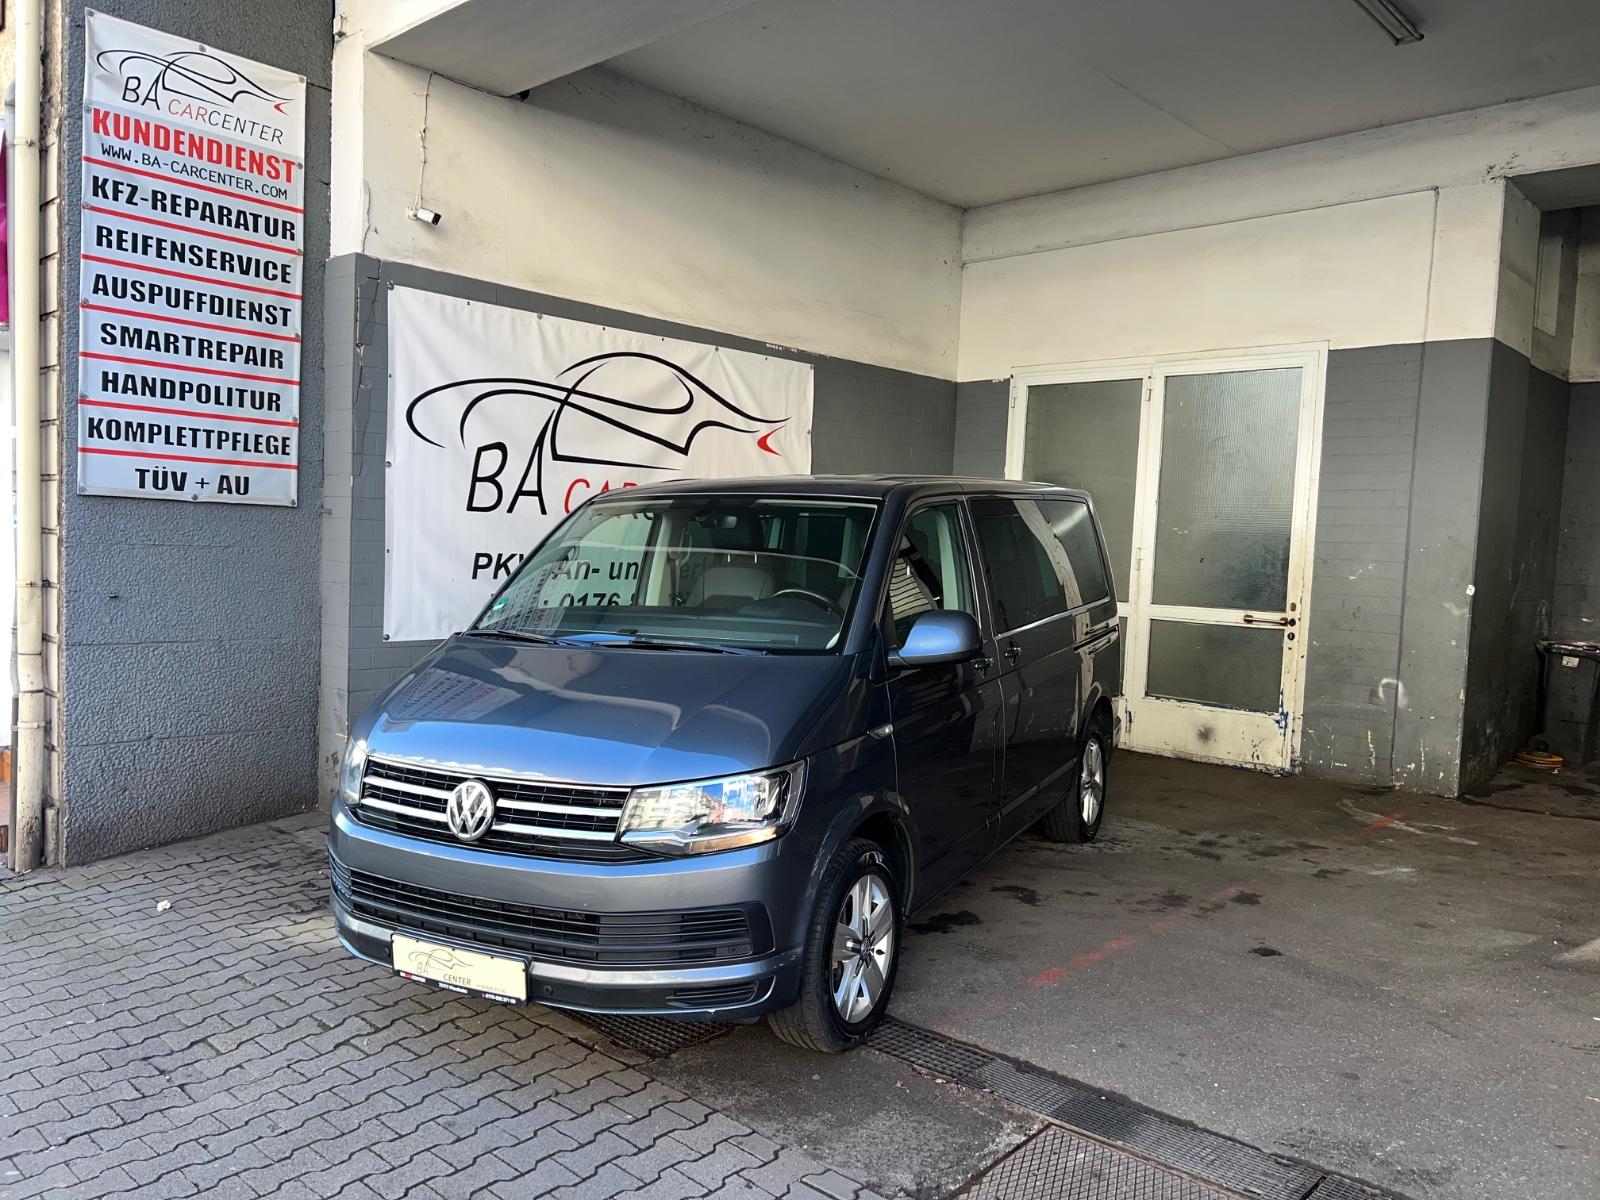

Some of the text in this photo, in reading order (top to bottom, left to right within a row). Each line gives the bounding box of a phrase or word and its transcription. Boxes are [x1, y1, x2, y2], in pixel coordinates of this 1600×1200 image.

[122, 70, 284, 144] BA CARCENTER
[92, 107, 296, 184] KUNDENDIENST
[101, 142, 288, 200] WWW.BA-CARCENTER.COM
[92, 175, 296, 241] KFZ-REPARATUR
[96, 225, 292, 284] REIFENSERVICE
[92, 273, 292, 327] AUSPUFFDIENST
[100, 322, 284, 369] SMARTREPAIR
[101, 370, 281, 412] HANDPOLITUR
[87, 417, 291, 456] KOMPLETTPFLEGE
[134, 465, 250, 496] TÜV + AU
[466, 412, 555, 516] BA
[471, 552, 524, 580] PK
[608, 561, 640, 580] un
[443, 973, 472, 986] CENTER
